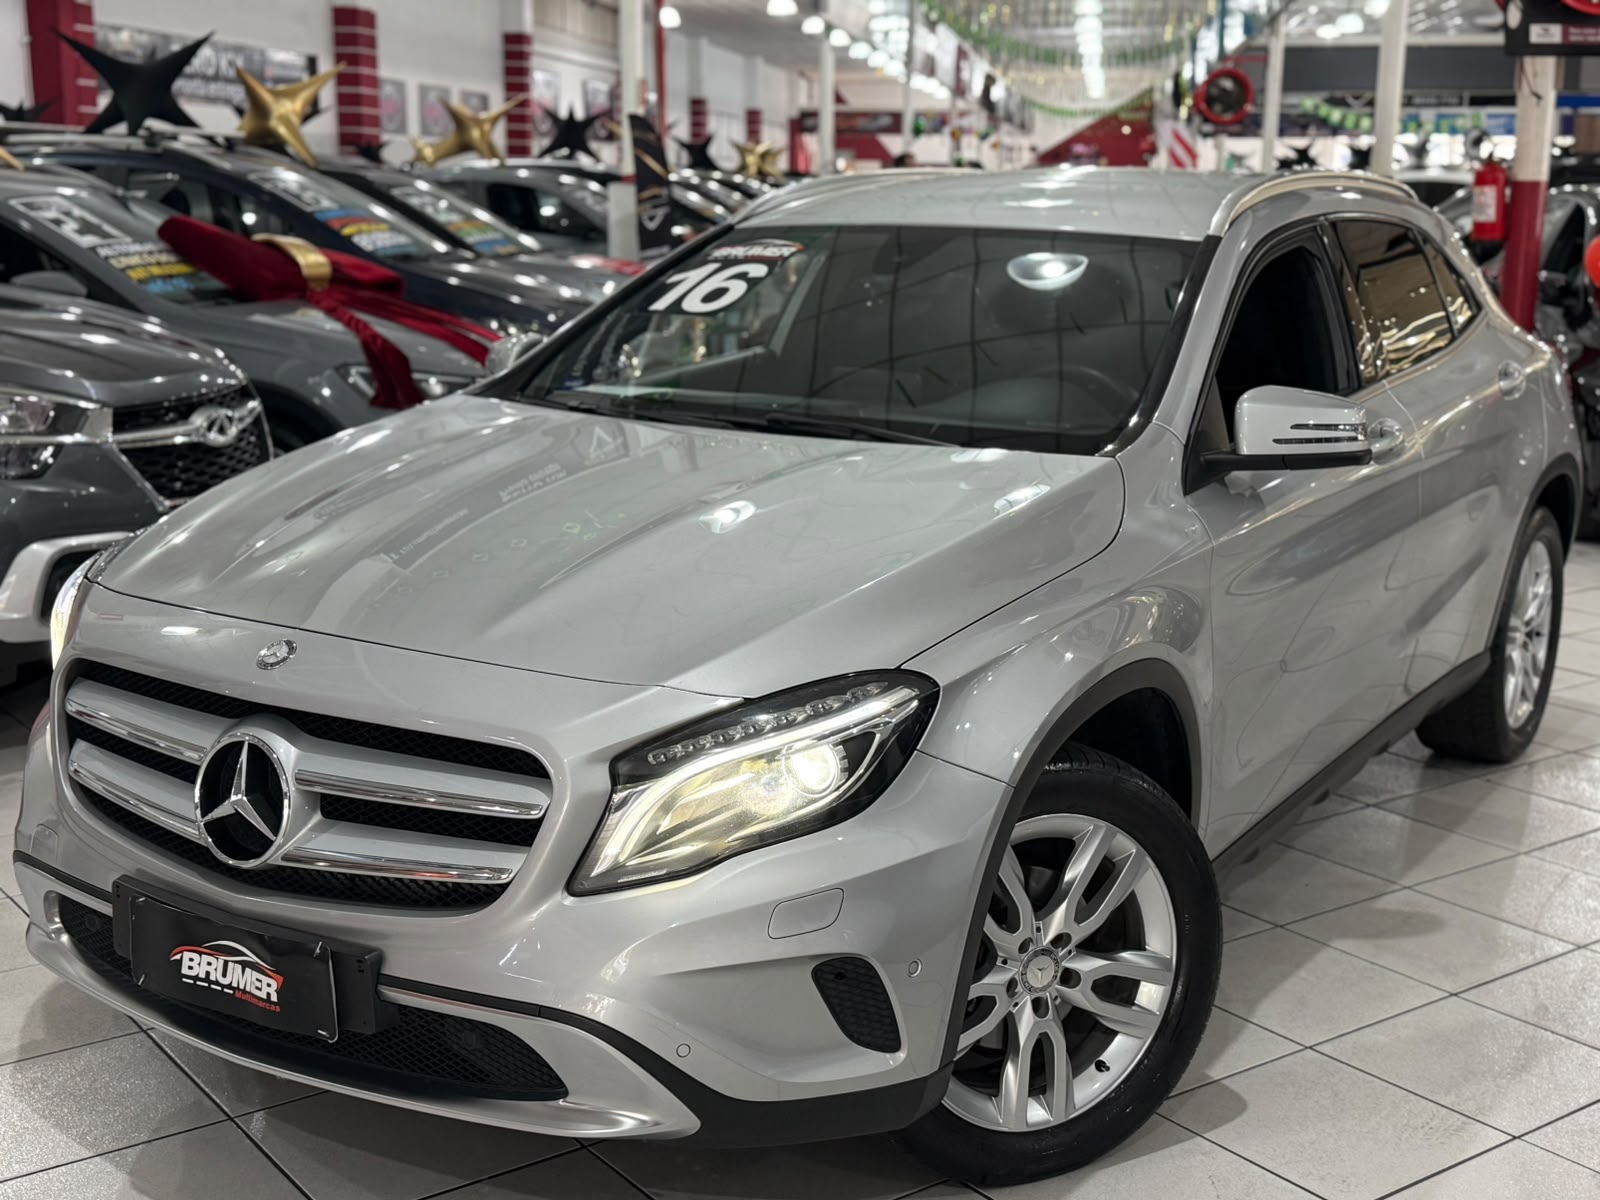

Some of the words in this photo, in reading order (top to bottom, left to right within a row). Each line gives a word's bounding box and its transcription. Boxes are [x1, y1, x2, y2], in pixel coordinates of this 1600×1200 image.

[648, 262, 769, 313] 16
[181, 950, 278, 1002] BRUMER
[235, 990, 281, 1012] Multimarcas
